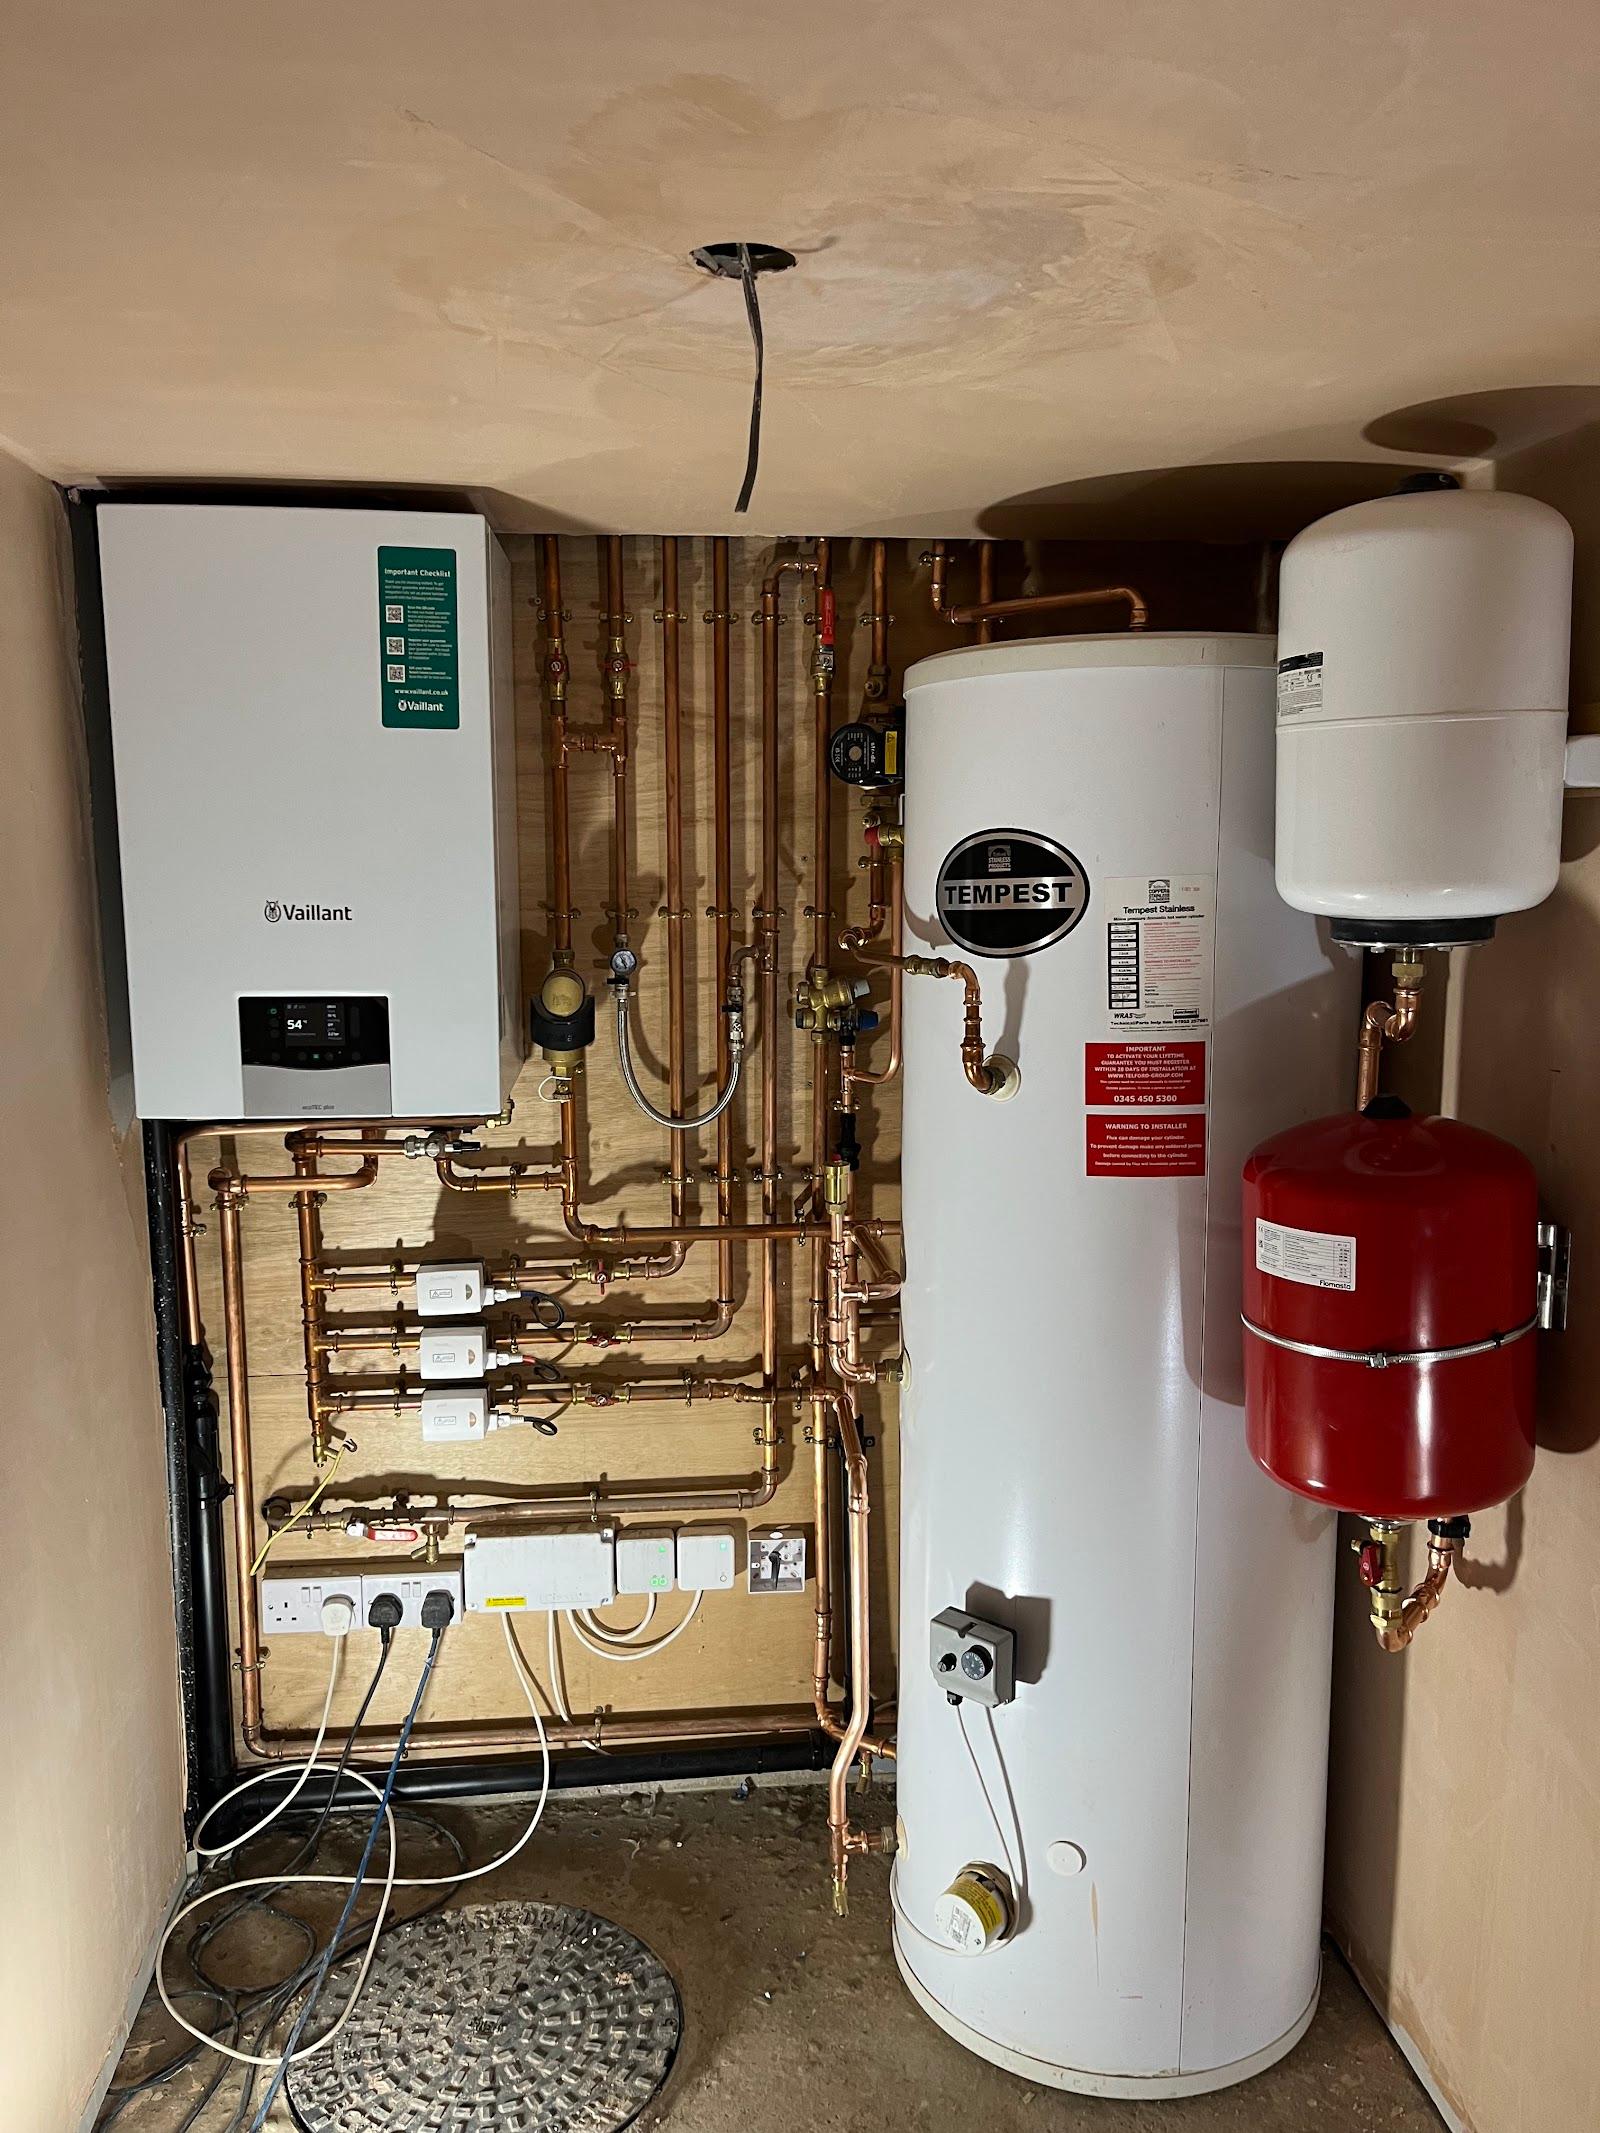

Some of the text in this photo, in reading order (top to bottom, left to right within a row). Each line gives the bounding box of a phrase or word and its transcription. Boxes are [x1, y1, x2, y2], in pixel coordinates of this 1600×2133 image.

[384, 568, 418, 576] Important
[394, 688, 448, 696] www.vaillant.co.uk
[408, 701, 444, 712] Vaillant
[944, 883, 1072, 904] TEMPEST
[283, 904, 353, 921] Vaillant
[1123, 905, 1195, 915] Tempest Stainless
[287, 1019, 303, 1030] 54
[1319, 1279, 1351, 1290] Flomasta
